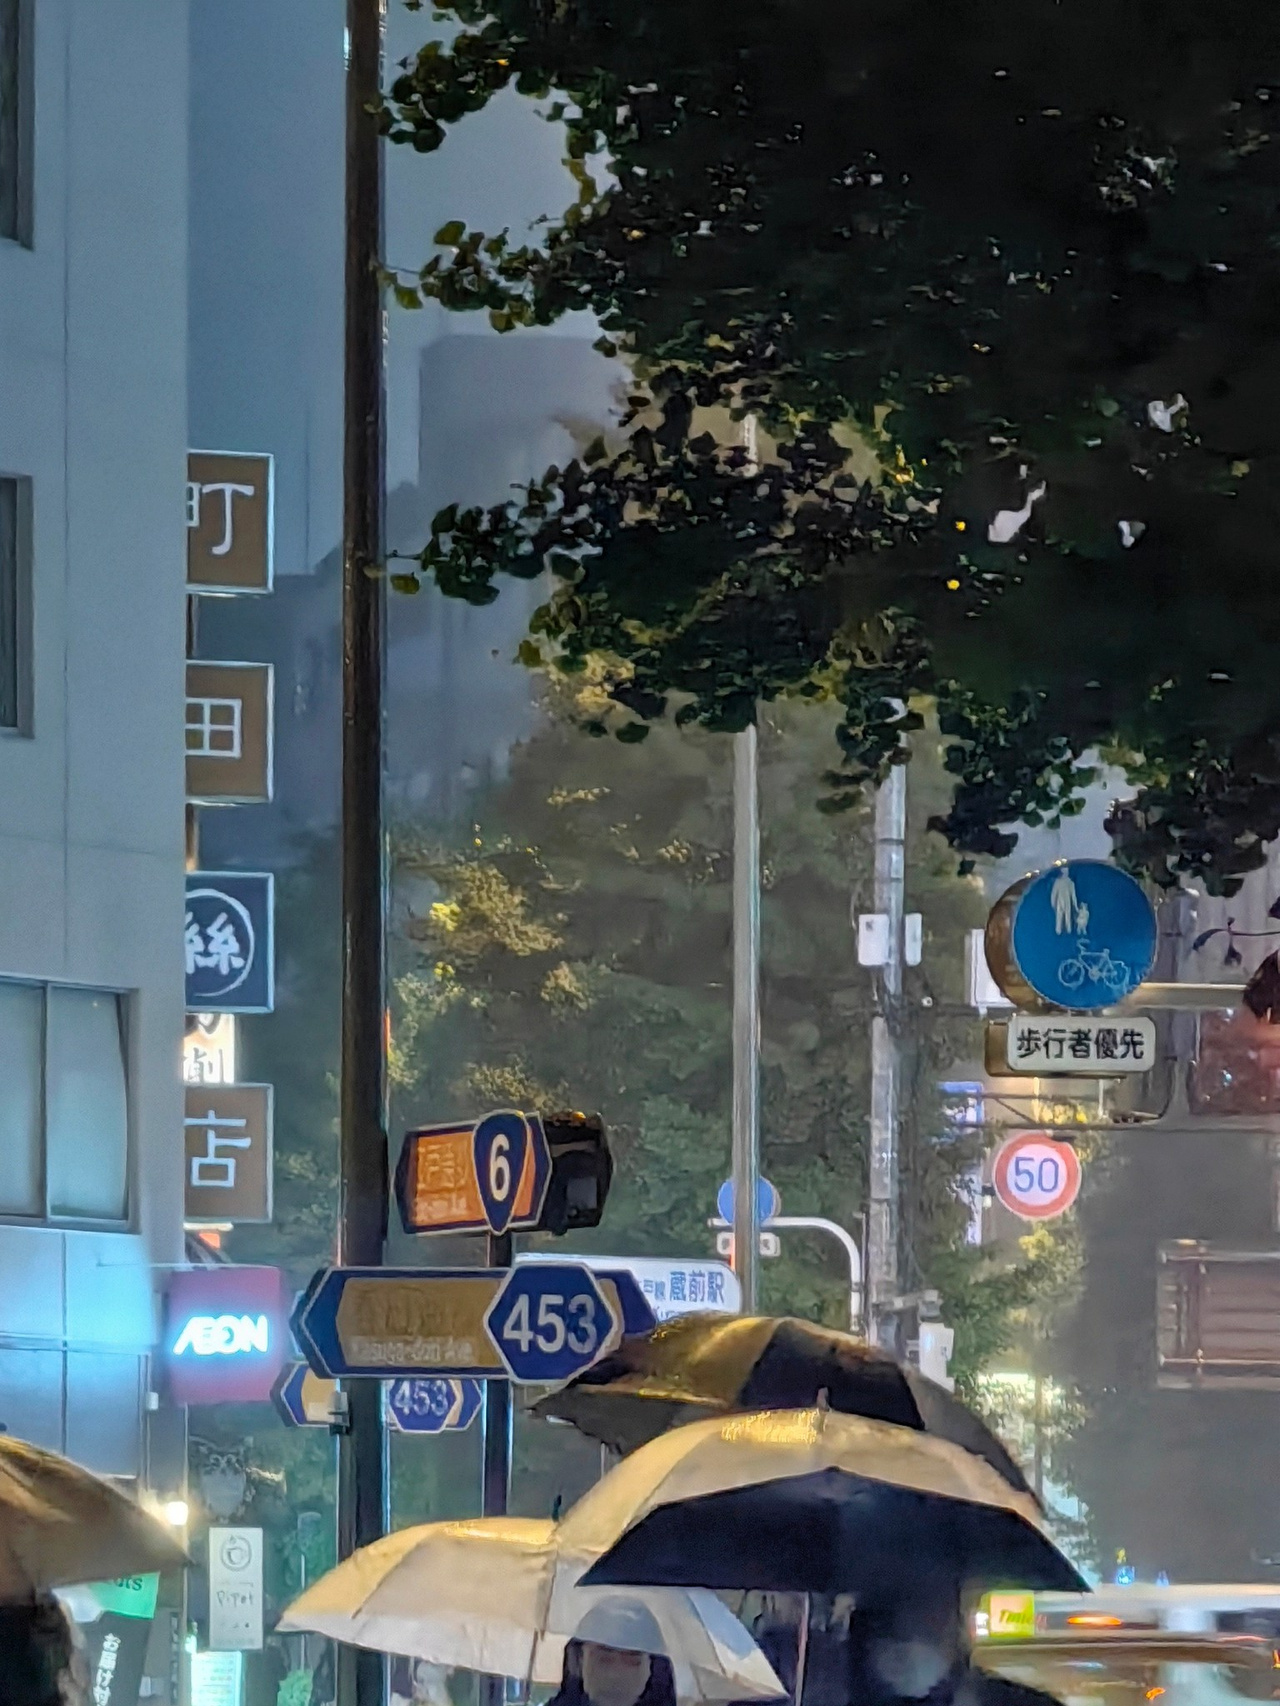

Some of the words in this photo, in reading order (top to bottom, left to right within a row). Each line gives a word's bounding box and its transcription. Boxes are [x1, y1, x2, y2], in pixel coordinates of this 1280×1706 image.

[1017, 1028, 1144, 1059] 歩行者優先
[489, 1133, 510, 1202] 6
[1014, 1156, 1059, 1193] 50
[502, 1293, 597, 1355] 453
[394, 1379, 448, 1416] 453
